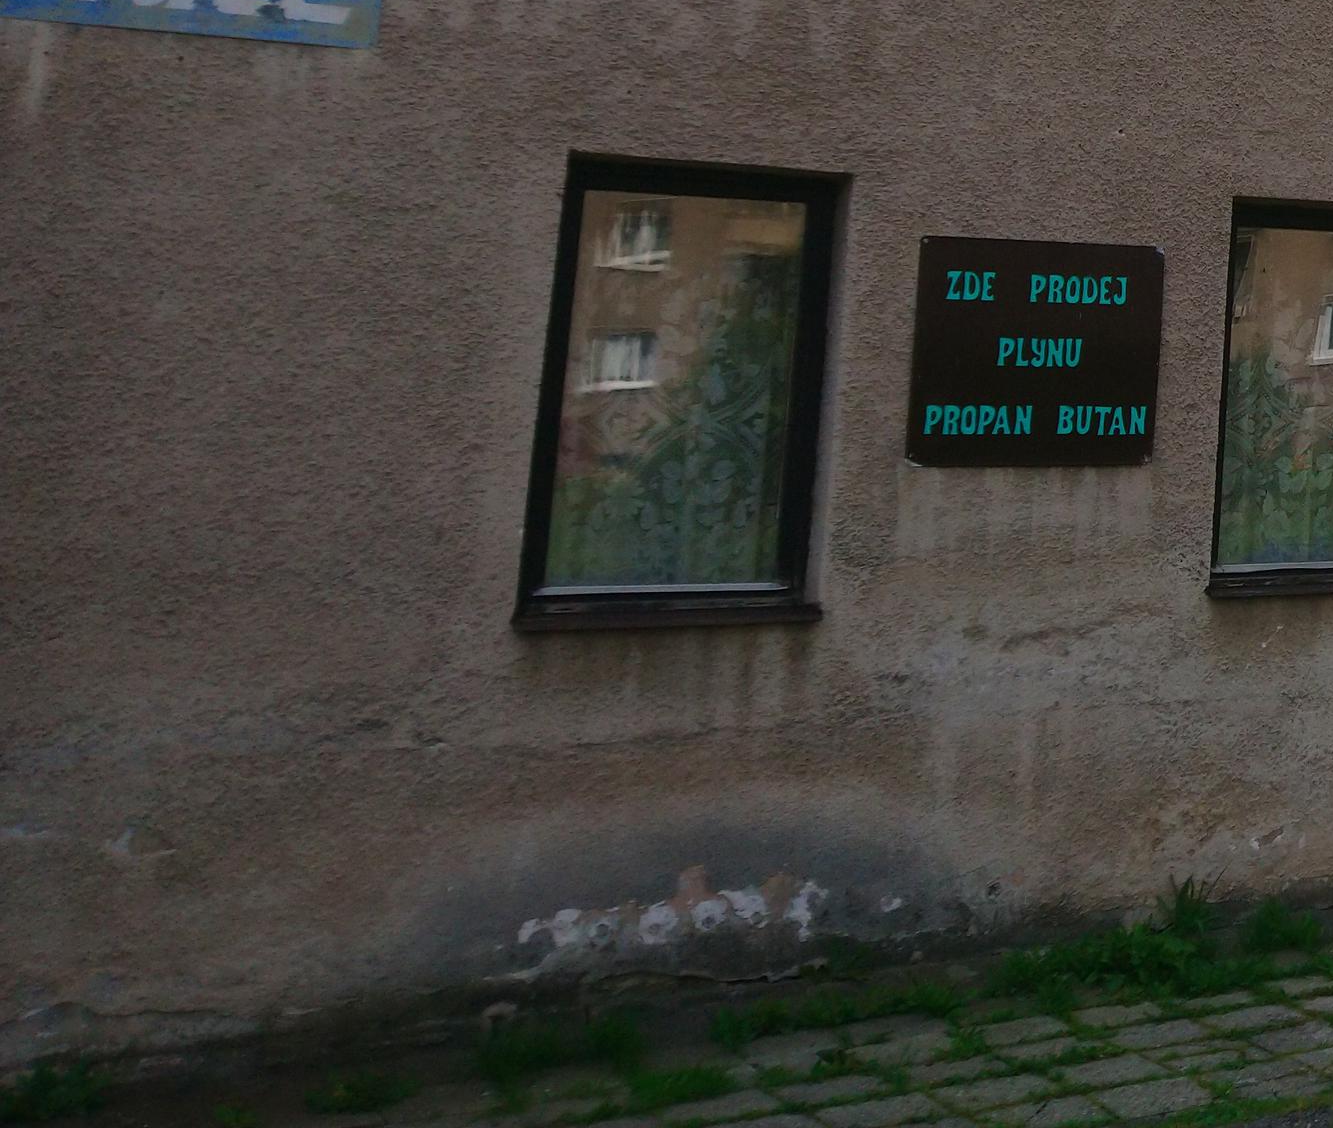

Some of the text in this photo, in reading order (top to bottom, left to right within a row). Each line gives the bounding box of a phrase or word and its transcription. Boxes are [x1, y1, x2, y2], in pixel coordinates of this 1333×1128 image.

[945, 271, 1128, 305] ZDE PRODEJ
[997, 337, 1083, 368] PLYNU
[923, 405, 1148, 436] PROPAN BUTAN
